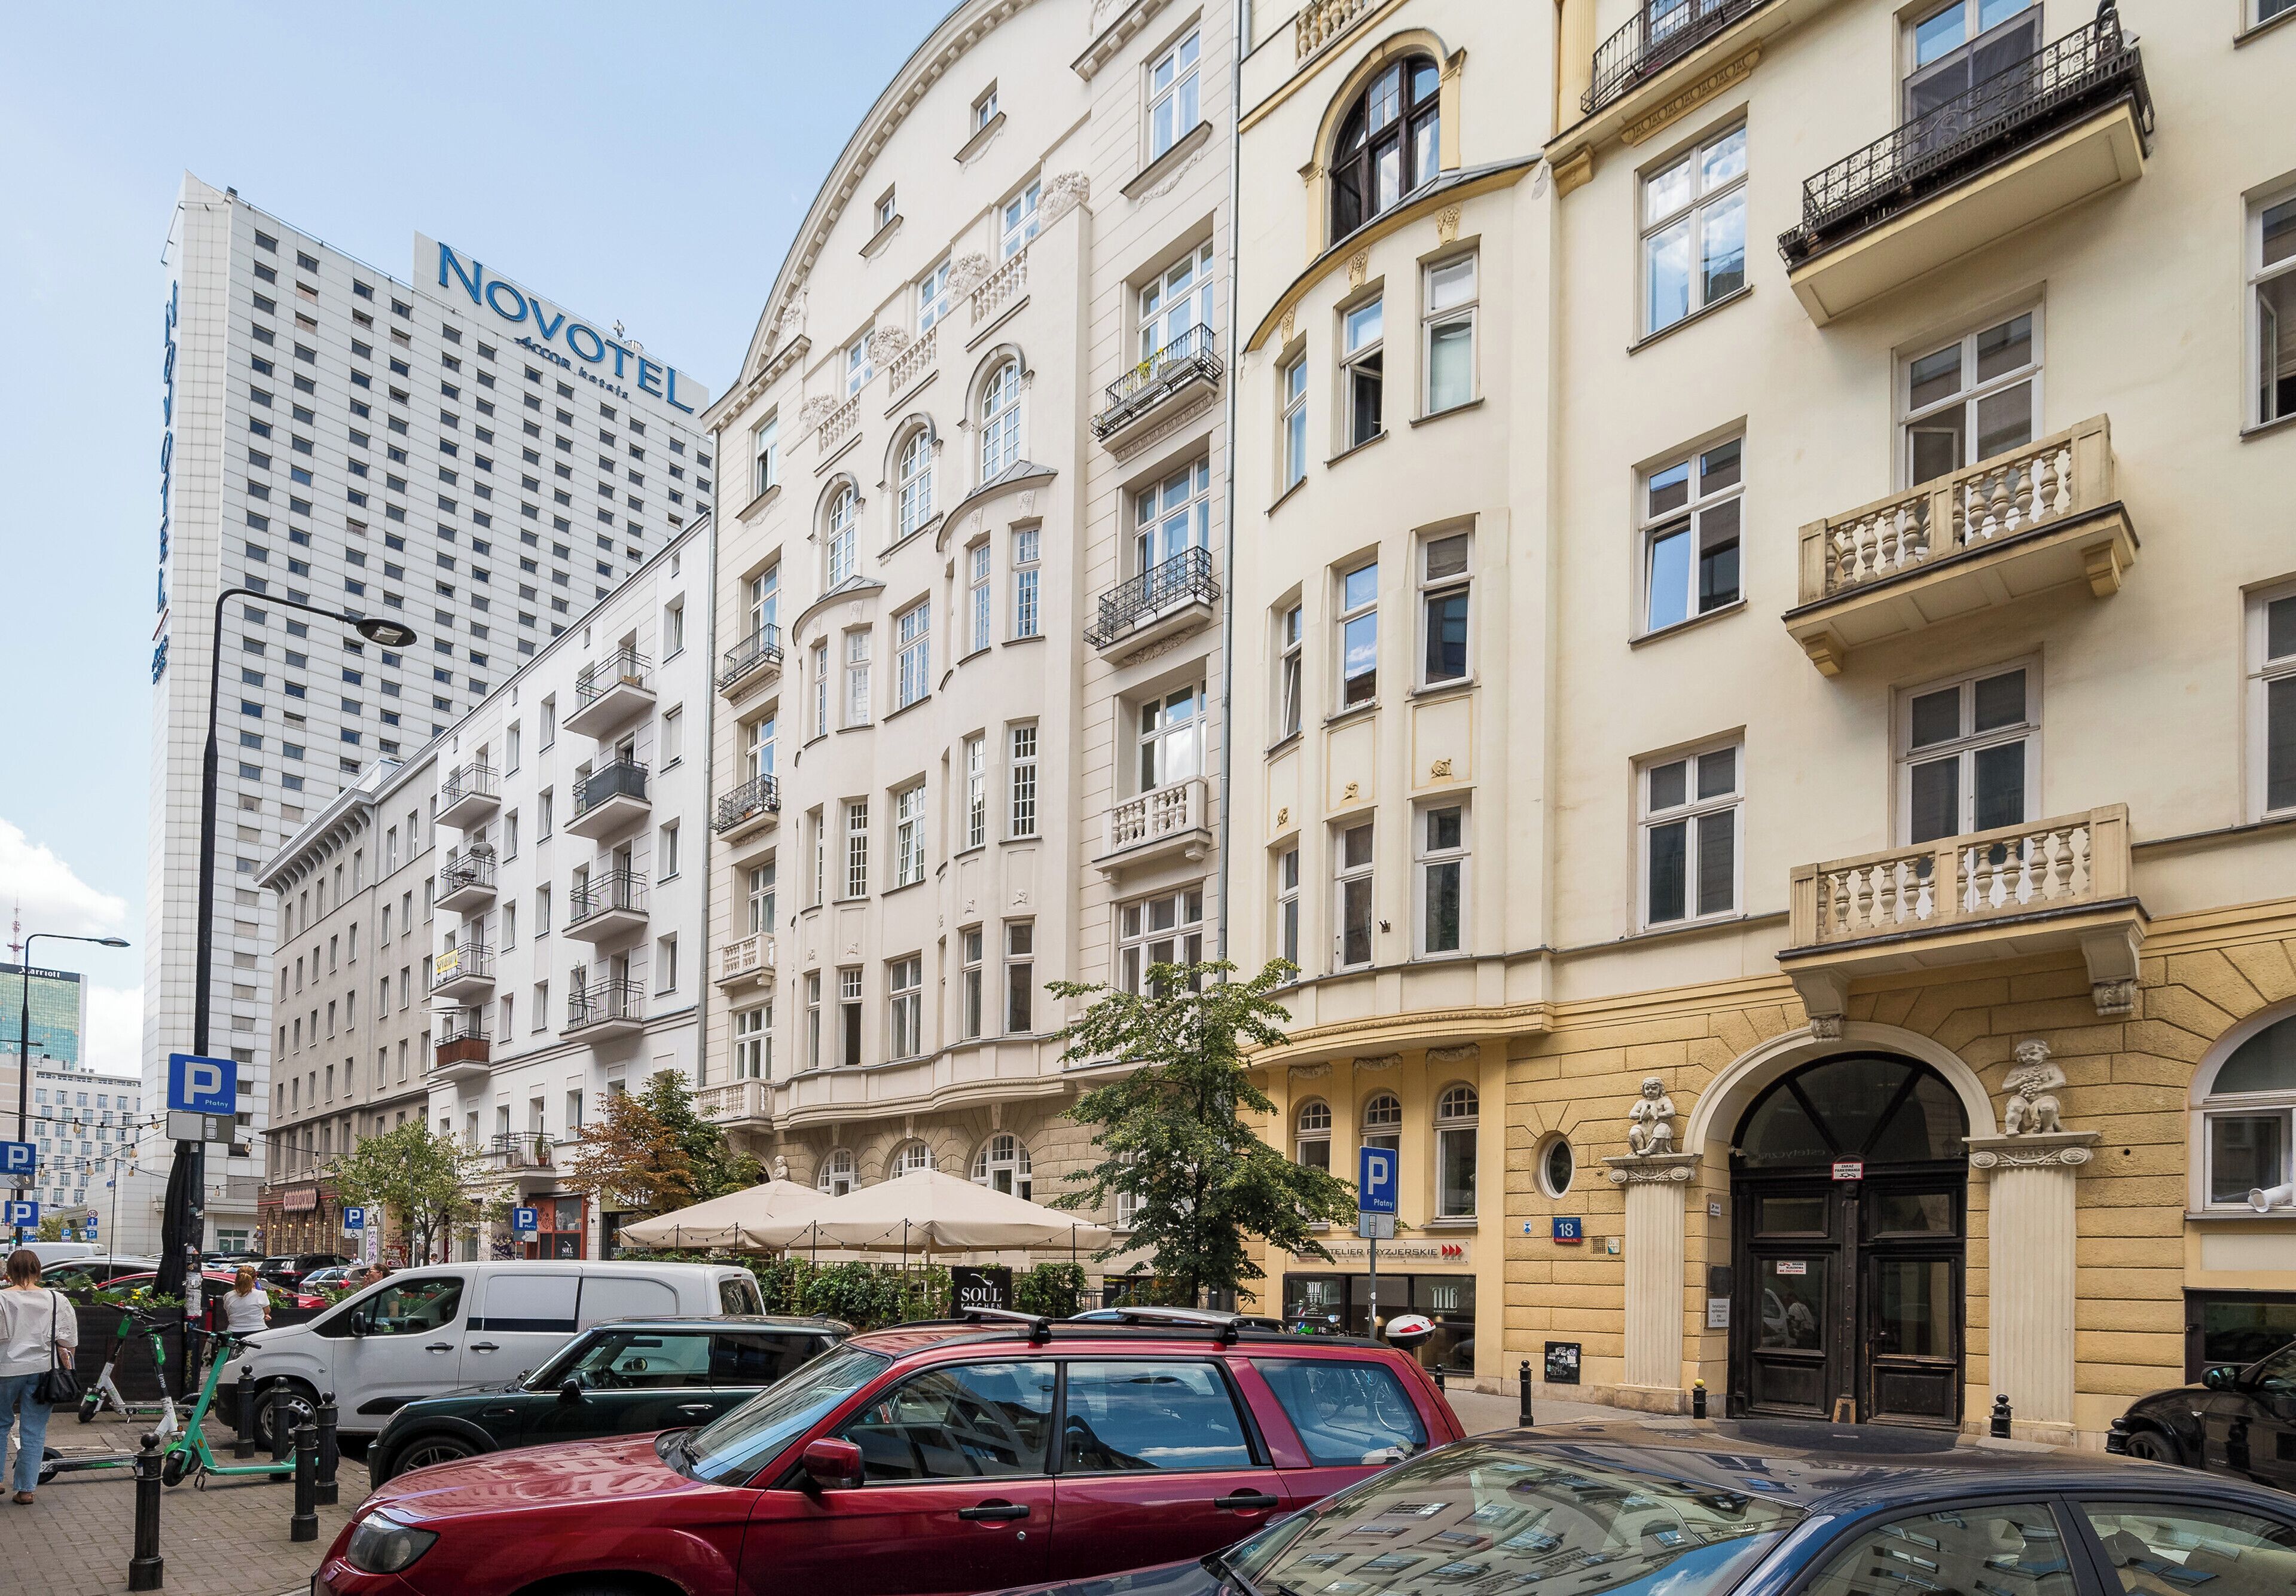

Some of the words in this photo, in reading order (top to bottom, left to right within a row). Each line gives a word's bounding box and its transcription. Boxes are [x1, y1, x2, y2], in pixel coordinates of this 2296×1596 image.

[438, 241, 694, 414] NOVOTEL
[514, 336, 572, 371] ACCOR
[579, 366, 628, 400] hotels
[184, 1062, 222, 1105] P
[205, 1099, 228, 1108] Płatny
[8, 1145, 29, 1169] P
[2014, 1149, 2045, 1158] 1912
[1367, 1155, 1388, 1195] P
[1373, 1198, 1393, 1209] Płatny
[13, 1203, 31, 1224] P
[349, 1209, 360, 1223] P
[519, 1210, 533, 1228] P
[1559, 1223, 1574, 1237] 18
[961, 1287, 1002, 1302] SOUL
